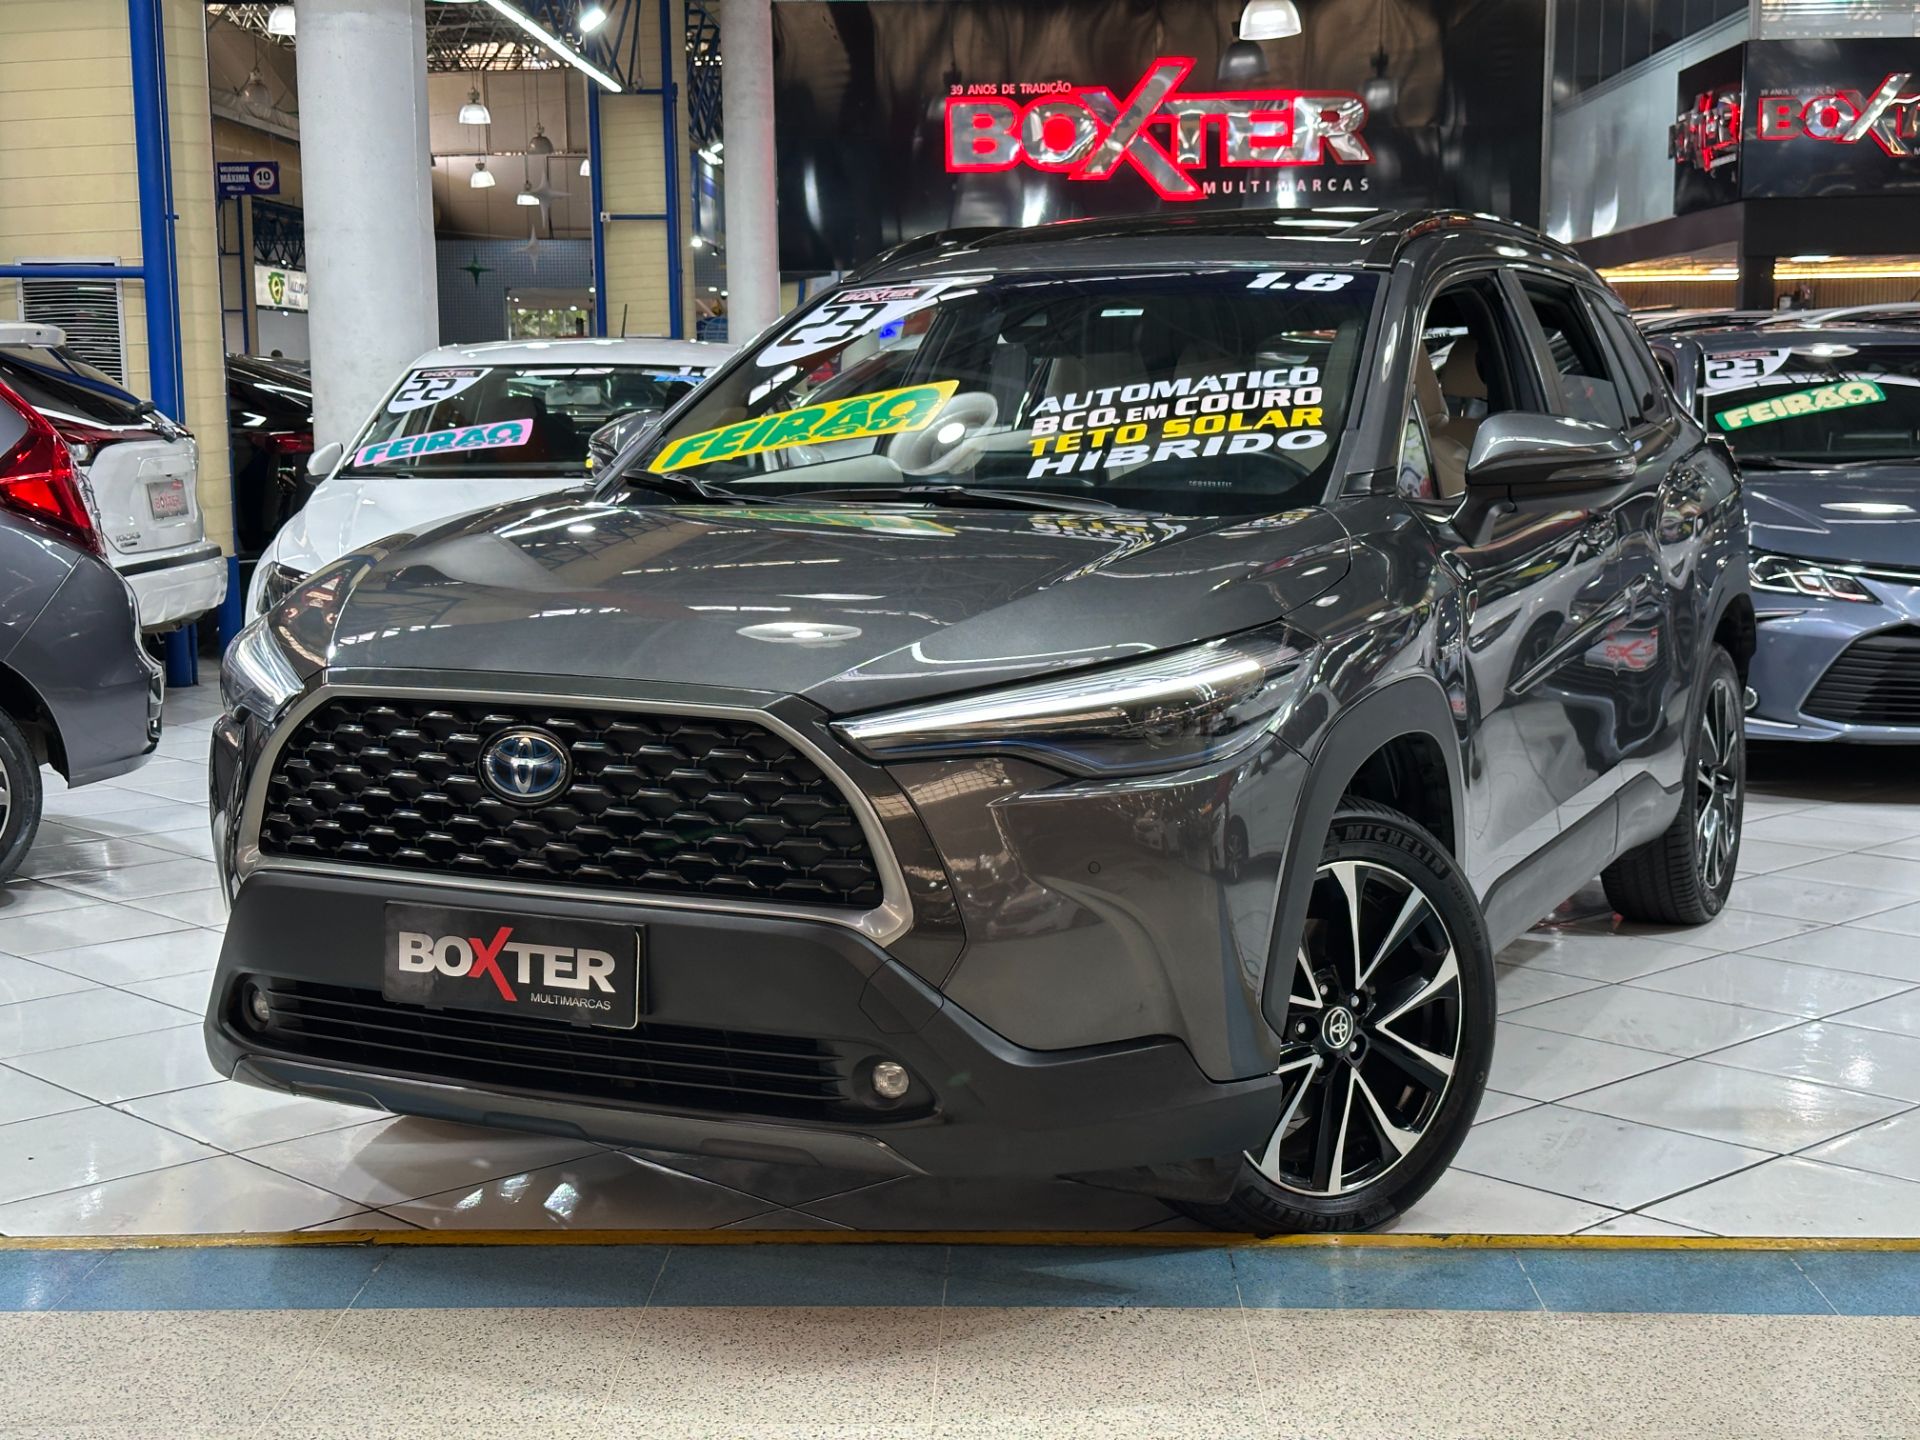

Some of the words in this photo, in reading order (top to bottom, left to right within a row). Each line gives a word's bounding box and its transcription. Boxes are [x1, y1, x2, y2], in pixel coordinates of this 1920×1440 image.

[950, 84, 963, 95] 39
[967, 84, 998, 95] ANOS
[1001, 83, 1015, 95] DE
[1020, 80, 1071, 94] TRADIÇÃO
[945, 57, 1374, 201] BOXTER
[1757, 72, 1920, 158] BOXT
[256, 171, 271, 181] 10
[1203, 178, 1369, 194] MULTIMARCAS
[838, 288, 920, 303] BOXTER
[1246, 271, 1354, 292] 1.8
[776, 303, 888, 347] 23
[1710, 359, 1765, 379] 23
[394, 379, 457, 402] 22
[1029, 367, 1320, 417] AUTOMÁTICO
[1126, 403, 1169, 423] EM
[1174, 387, 1323, 416] COURO
[1029, 423, 1147, 457] TETO
[1161, 407, 1323, 438] SOLAR
[1344, 825, 1447, 874] MICHELIN
[399, 926, 616, 1002] BOXTER
[531, 993, 611, 1010] MULTIMARCAS
